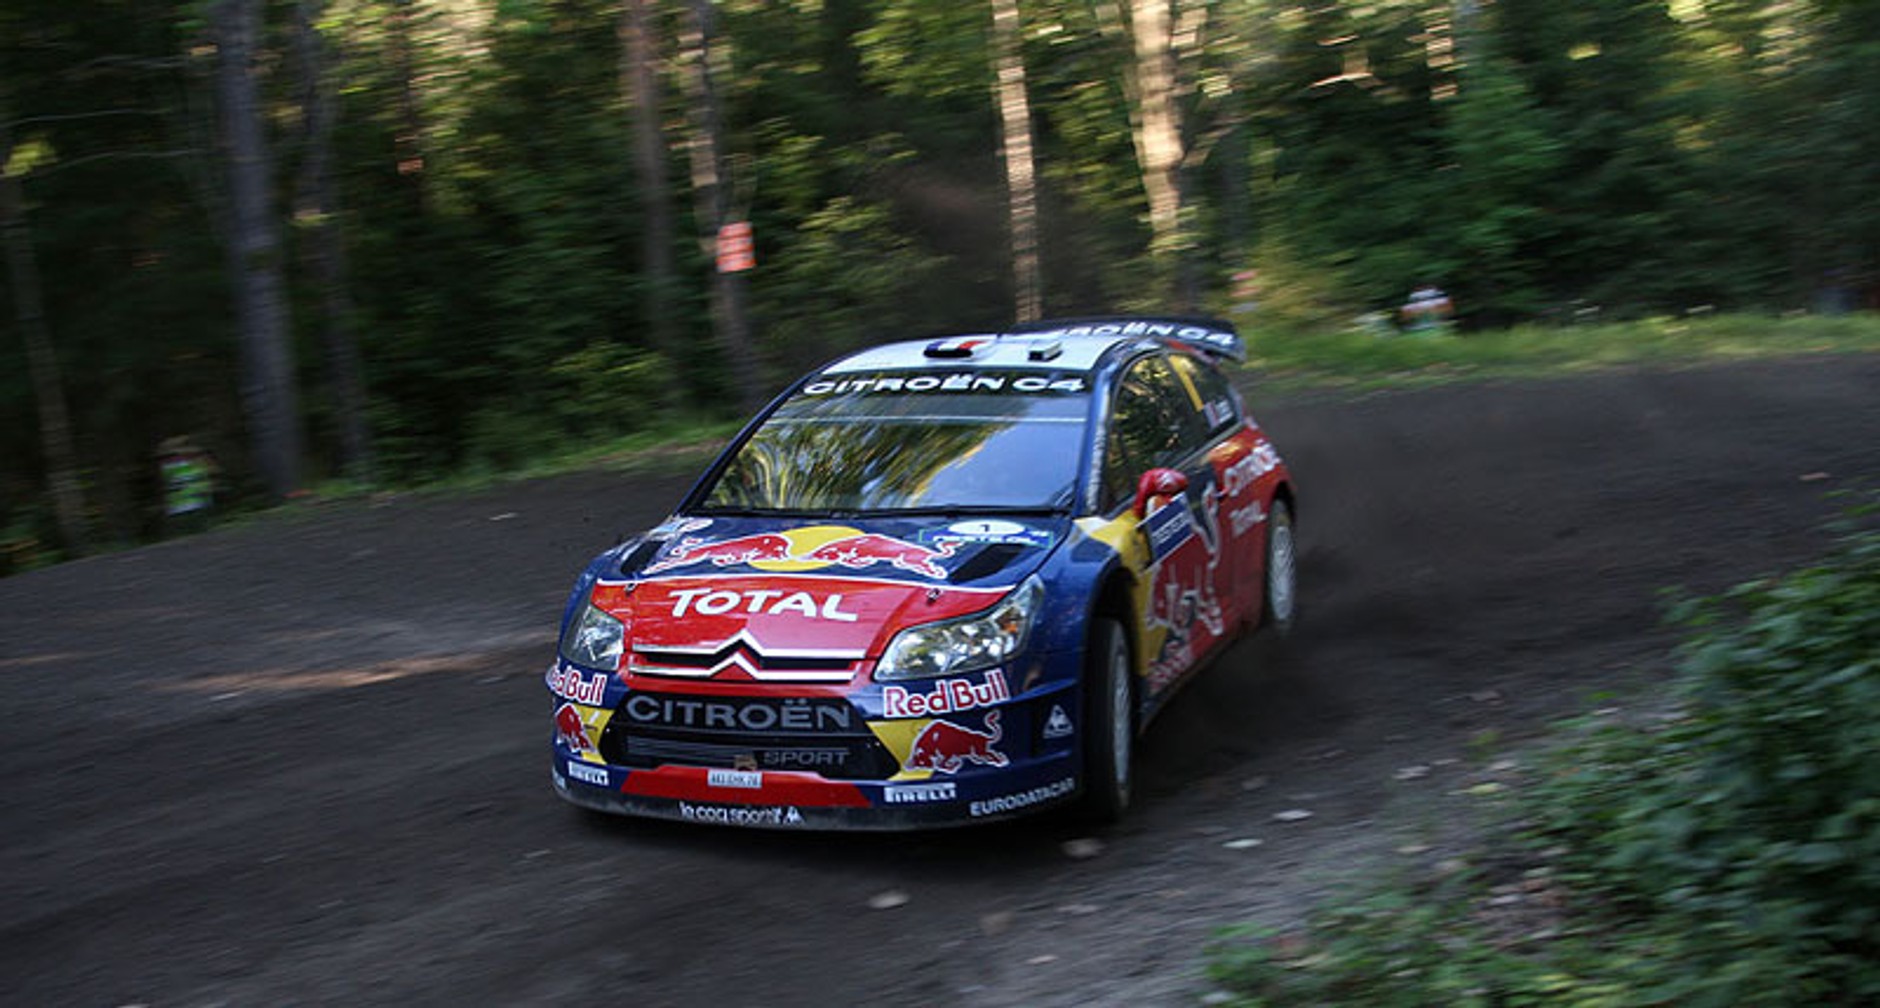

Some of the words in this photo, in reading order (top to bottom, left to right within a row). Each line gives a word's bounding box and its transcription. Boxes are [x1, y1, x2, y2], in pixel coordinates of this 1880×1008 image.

[803, 373, 1004, 395] CITROËN
[1012, 376, 1086, 392] C4
[668, 587, 858, 622] TOTAL
[565, 669, 608, 706] Bull
[884, 679, 949, 717] Red
[950, 669, 1010, 711] Bull
[626, 695, 851, 731] CITROËN
[763, 751, 852, 765] SPORT
[884, 783, 956, 802] PIRELLI
[696, 806, 728, 824] coq
